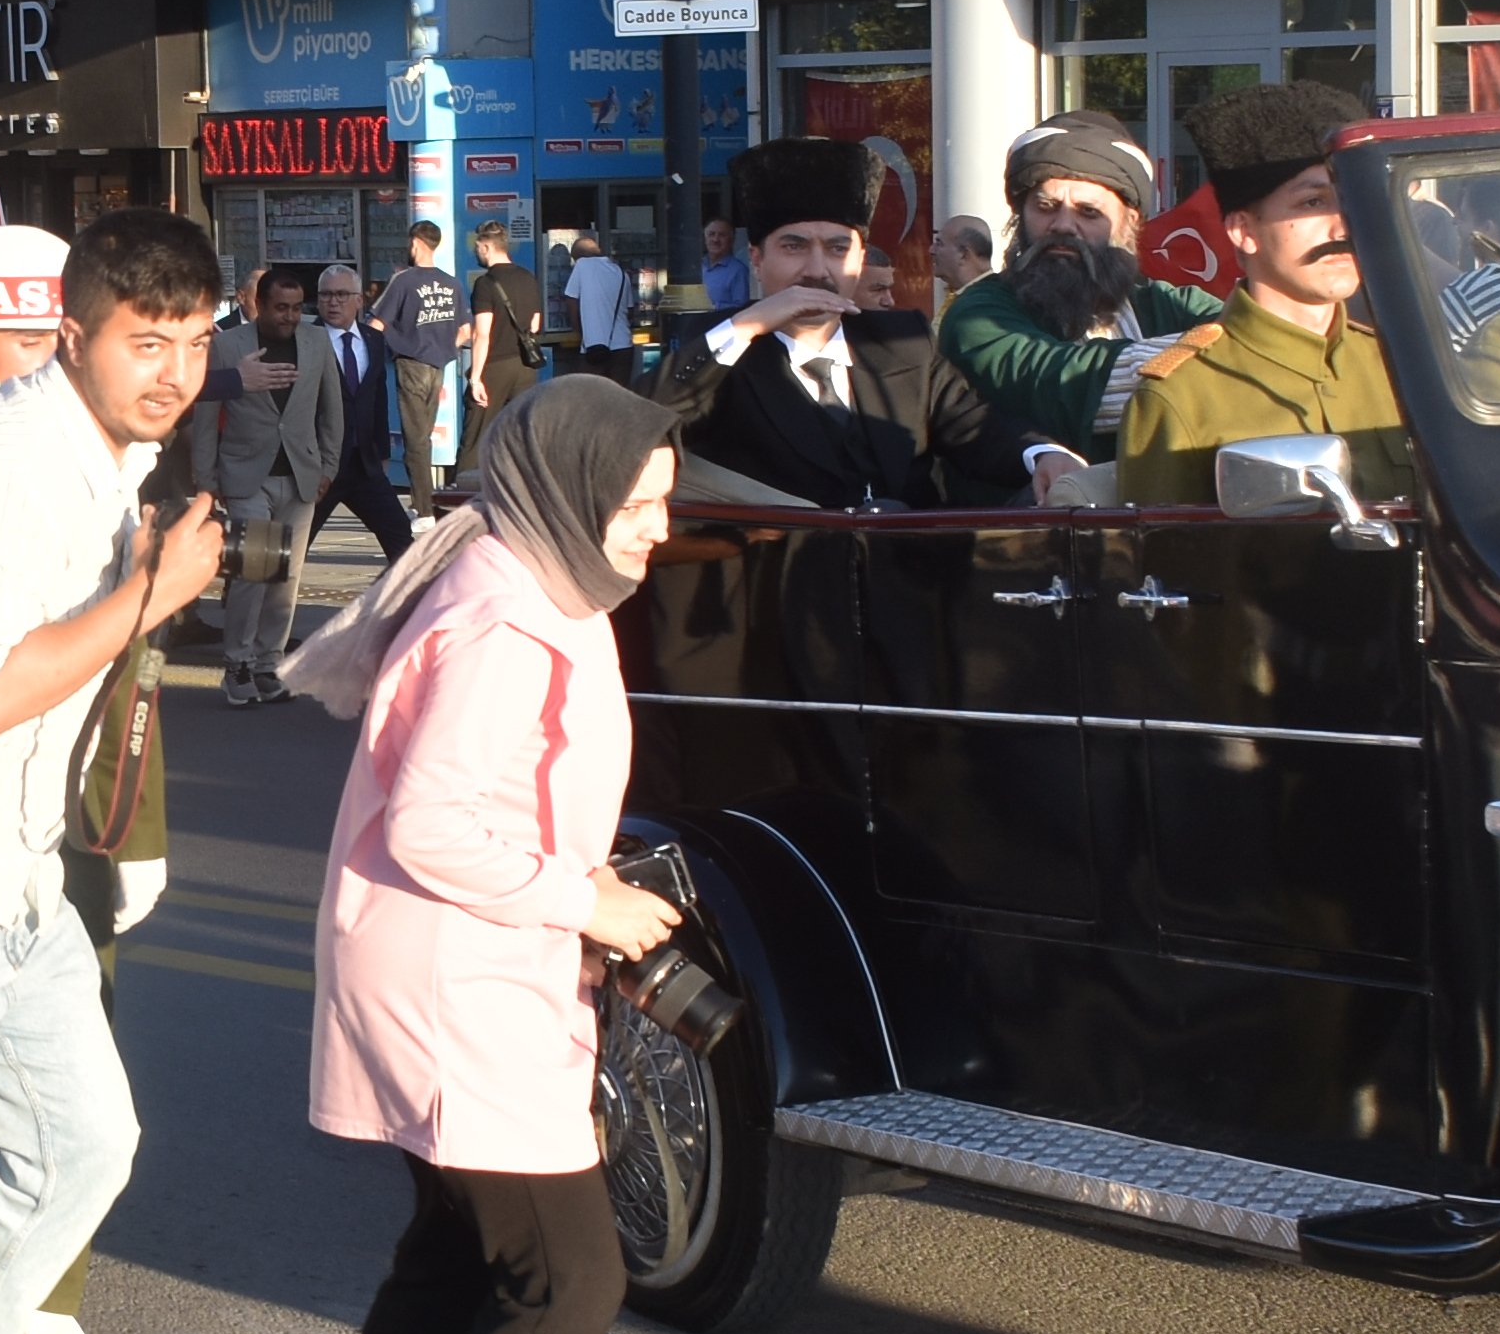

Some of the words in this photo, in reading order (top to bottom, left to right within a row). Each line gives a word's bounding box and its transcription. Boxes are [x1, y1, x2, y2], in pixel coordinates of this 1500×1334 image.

[624, 9, 675, 24] Cadde
[681, 7, 749, 24] Boyunca
[294, 28, 372, 62] piyango
[570, 47, 665, 71] HERKES
[264, 87, 311, 106] ŞERBETÇİ
[313, 85, 340, 103] BÜFE
[203, 118, 314, 175] SAYISAL
[132, 701, 149, 735] EOS
